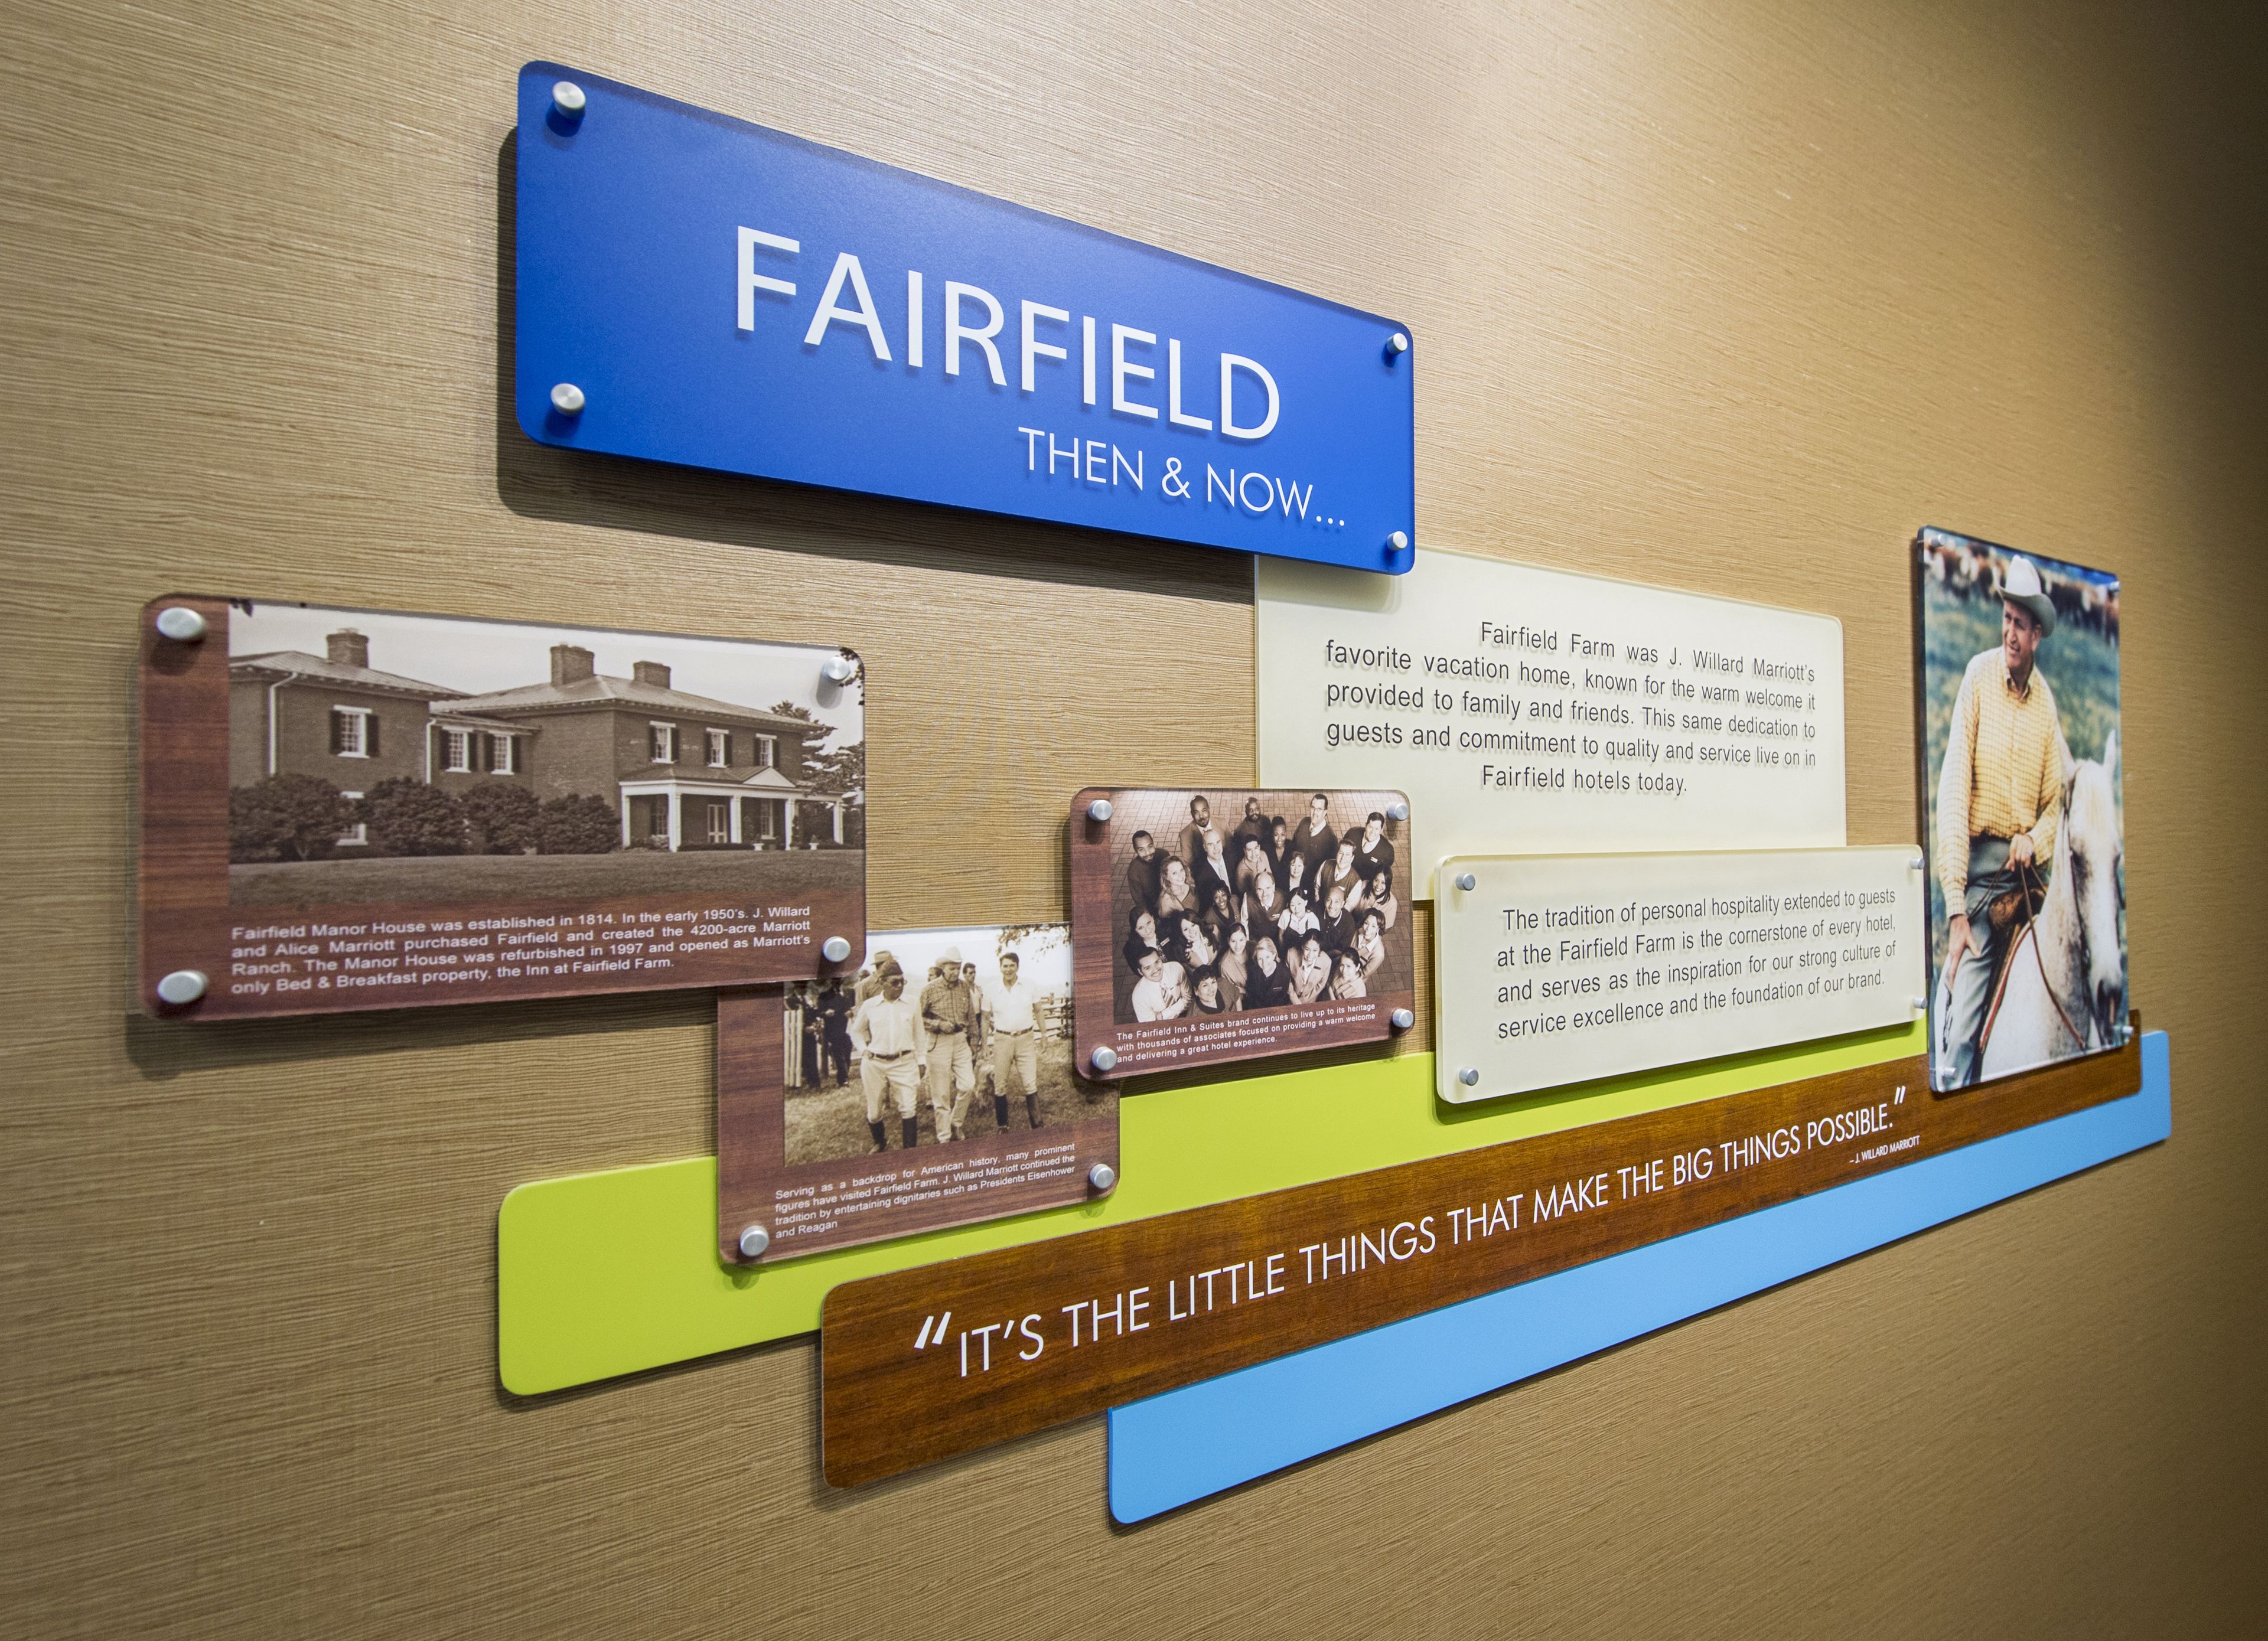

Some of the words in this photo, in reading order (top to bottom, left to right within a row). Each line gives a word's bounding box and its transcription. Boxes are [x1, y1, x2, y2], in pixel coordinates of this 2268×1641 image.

[738, 226, 1280, 439] FAIRFIELD
[1018, 426, 1143, 491] THEN
[1162, 457, 1191, 498] &
[1207, 462, 1345, 526] NOW...
[1326, 639, 1412, 670] favorite
[1424, 655, 1509, 680] vacation
[1520, 661, 1575, 689] home,
[1586, 668, 1637, 692] known
[1644, 675, 1666, 695] for
[1672, 678, 1695, 698] the
[1702, 686, 1739, 702] warm
[1746, 689, 1803, 709] welcome
[1808, 693, 1815, 710] it
[1482, 621, 1557, 651] Fairfield
[1572, 634, 1614, 657] Farm
[1627, 645, 1658, 663] was
[1670, 647, 1682, 665] J.
[1693, 650, 1743, 673] Willard
[1754, 658, 1814, 682] Marriott's
[1328, 683, 1423, 708] provided
[1433, 689, 1453, 710] to
[1462, 690, 1521, 720] family
[1530, 699, 1562, 719] and
[1571, 700, 1634, 724] friends.
[1642, 706, 1675, 727] This
[1682, 715, 1722, 731] same
[1729, 715, 1798, 736] dedication
[1804, 722, 1816, 738] to
[1327, 722, 1403, 746] guests
[1412, 725, 1450, 746] and
[1460, 730, 1576, 753] commitment
[1583, 736, 1598, 755] to
[1606, 738, 1659, 763] quality
[1666, 742, 1693, 760] and
[1700, 744, 1751, 763] service
[1757, 746, 1779, 764] live
[1784, 752, 1800, 765] on
[1806, 749, 1816, 766] in
[1483, 765, 1565, 788] Fairfield
[1575, 769, 1630, 790] hotels
[1638, 772, 1687, 797] today.
[232, 925, 306, 939] Fairfield
[312, 924, 367, 937] Manor
[372, 922, 426, 934] House
[431, 921, 463, 931] was
[468, 916, 555, 930] established
[560, 915, 573, 926] in
[578, 914, 617, 925] 1814.
[623, 913, 635, 924] In
[639, 912, 662, 923] the
[665, 911, 698, 923] early
[752, 908, 764, 918] J.
[768, 906, 810, 917] Willard
[1503, 909, 1539, 930] The
[1545, 905, 1614, 928] tradition
[1621, 902, 1636, 922] of
[1642, 898, 1706, 926] personal
[1712, 895, 1780, 919] hospitality
[1784, 890, 1840, 911] extended
[1844, 890, 1855, 906] to
[1859, 889, 1895, 909] guests
[232, 944, 266, 958] and
[275, 943, 319, 955] Alice
[330, 939, 395, 953] Marriott
[404, 934, 488, 952] purchased
[498, 932, 558, 945] Fairfield
[566, 929, 594, 942] and
[602, 927, 654, 940] created
[662, 926, 683, 937] the
[690, 924, 756, 935] 4200-acre
[763, 921, 810, 932] Marriott
[231, 980, 270, 995] only
[276, 977, 311, 991] Bed
[317, 976, 330, 988] &
[337, 972, 417, 988] Breakfast
[497, 966, 521, 977] the
[526, 965, 549, 976] Inn
[554, 963, 568, 974] at
[573, 959, 630, 973] Fairfield
[1498, 978, 1531, 1003] and
[1542, 977, 1601, 998] serves
[1609, 974, 1628, 990] as
[1636, 967, 1660, 987] the
[1669, 958, 1742, 985] inspiration
[1748, 955, 1767, 973] for
[1772, 955, 1793, 970] our
[1799, 951, 1836, 968] strong
[1842, 944, 1881, 962] culture
[1885, 940, 1896, 957] of
[1116, 1032, 1133, 1040] The
[1136, 1027, 1171, 1039] Fairfield
[1190, 1024, 1196, 1032] &
[1200, 1022, 1224, 1031] Suites
[1227, 1017, 1249, 1027] brand
[1252, 1014, 1289, 1024] continues
[1347, 1004, 1375, 1013] heritage
[1498, 1013, 1566, 1039] service
[1573, 1002, 1663, 1028] excellence
[1670, 993, 1697, 1014] and
[1703, 991, 1726, 1010] the
[1732, 981, 1803, 1006] foundation
[1808, 977, 1820, 995] of
[1824, 978, 1844, 993] our
[1848, 969, 1884, 989] brand.
[1115, 1053, 1133, 1063] and
[1136, 1049, 1177, 1061] delivering
[1187, 1044, 1209, 1055] great
[1211, 1040, 1231, 1050] hotel
[1233, 1036, 1278, 1048] experience.
[1861, 1144, 1889, 1161] WILLARD
[1889, 1135, 1920, 1153] MARRIOTT
[774, 1200, 810, 1214] figures
[813, 1196, 838, 1206] have
[840, 1188, 871, 1201] visited
[874, 1181, 911, 1196] Fairfield
[943, 1175, 950, 1184] J.
[953, 1169, 983, 1182] Willard
[986, 1164, 1018, 1176] Marriott
[1020, 1156, 1060, 1170] continued
[1062, 1155, 1076, 1163] the
[775, 1212, 816, 1226] tradition
[819, 1209, 832, 1219] by
[834, 1199, 891, 1215] entertaining
[894, 1190, 941, 1205] dignitaries
[943, 1185, 964, 1196] such
[967, 1183, 978, 1192] as
[980, 1175, 1025, 1189] Presidents
[1027, 1166, 1075, 1181] Eisenhower
[1062, 1286, 1149, 1347] THE
[1169, 1253, 1285, 1321] LITTLE
[1299, 1216, 1436, 1284] THINGS
[1447, 1193, 1523, 1245] THAT
[1533, 1173, 1608, 1224] MAKE
[1617, 1159, 1664, 1199] THE
[1673, 1148, 1713, 1186] BIG
[1719, 1125, 1801, 1172] THINGS
